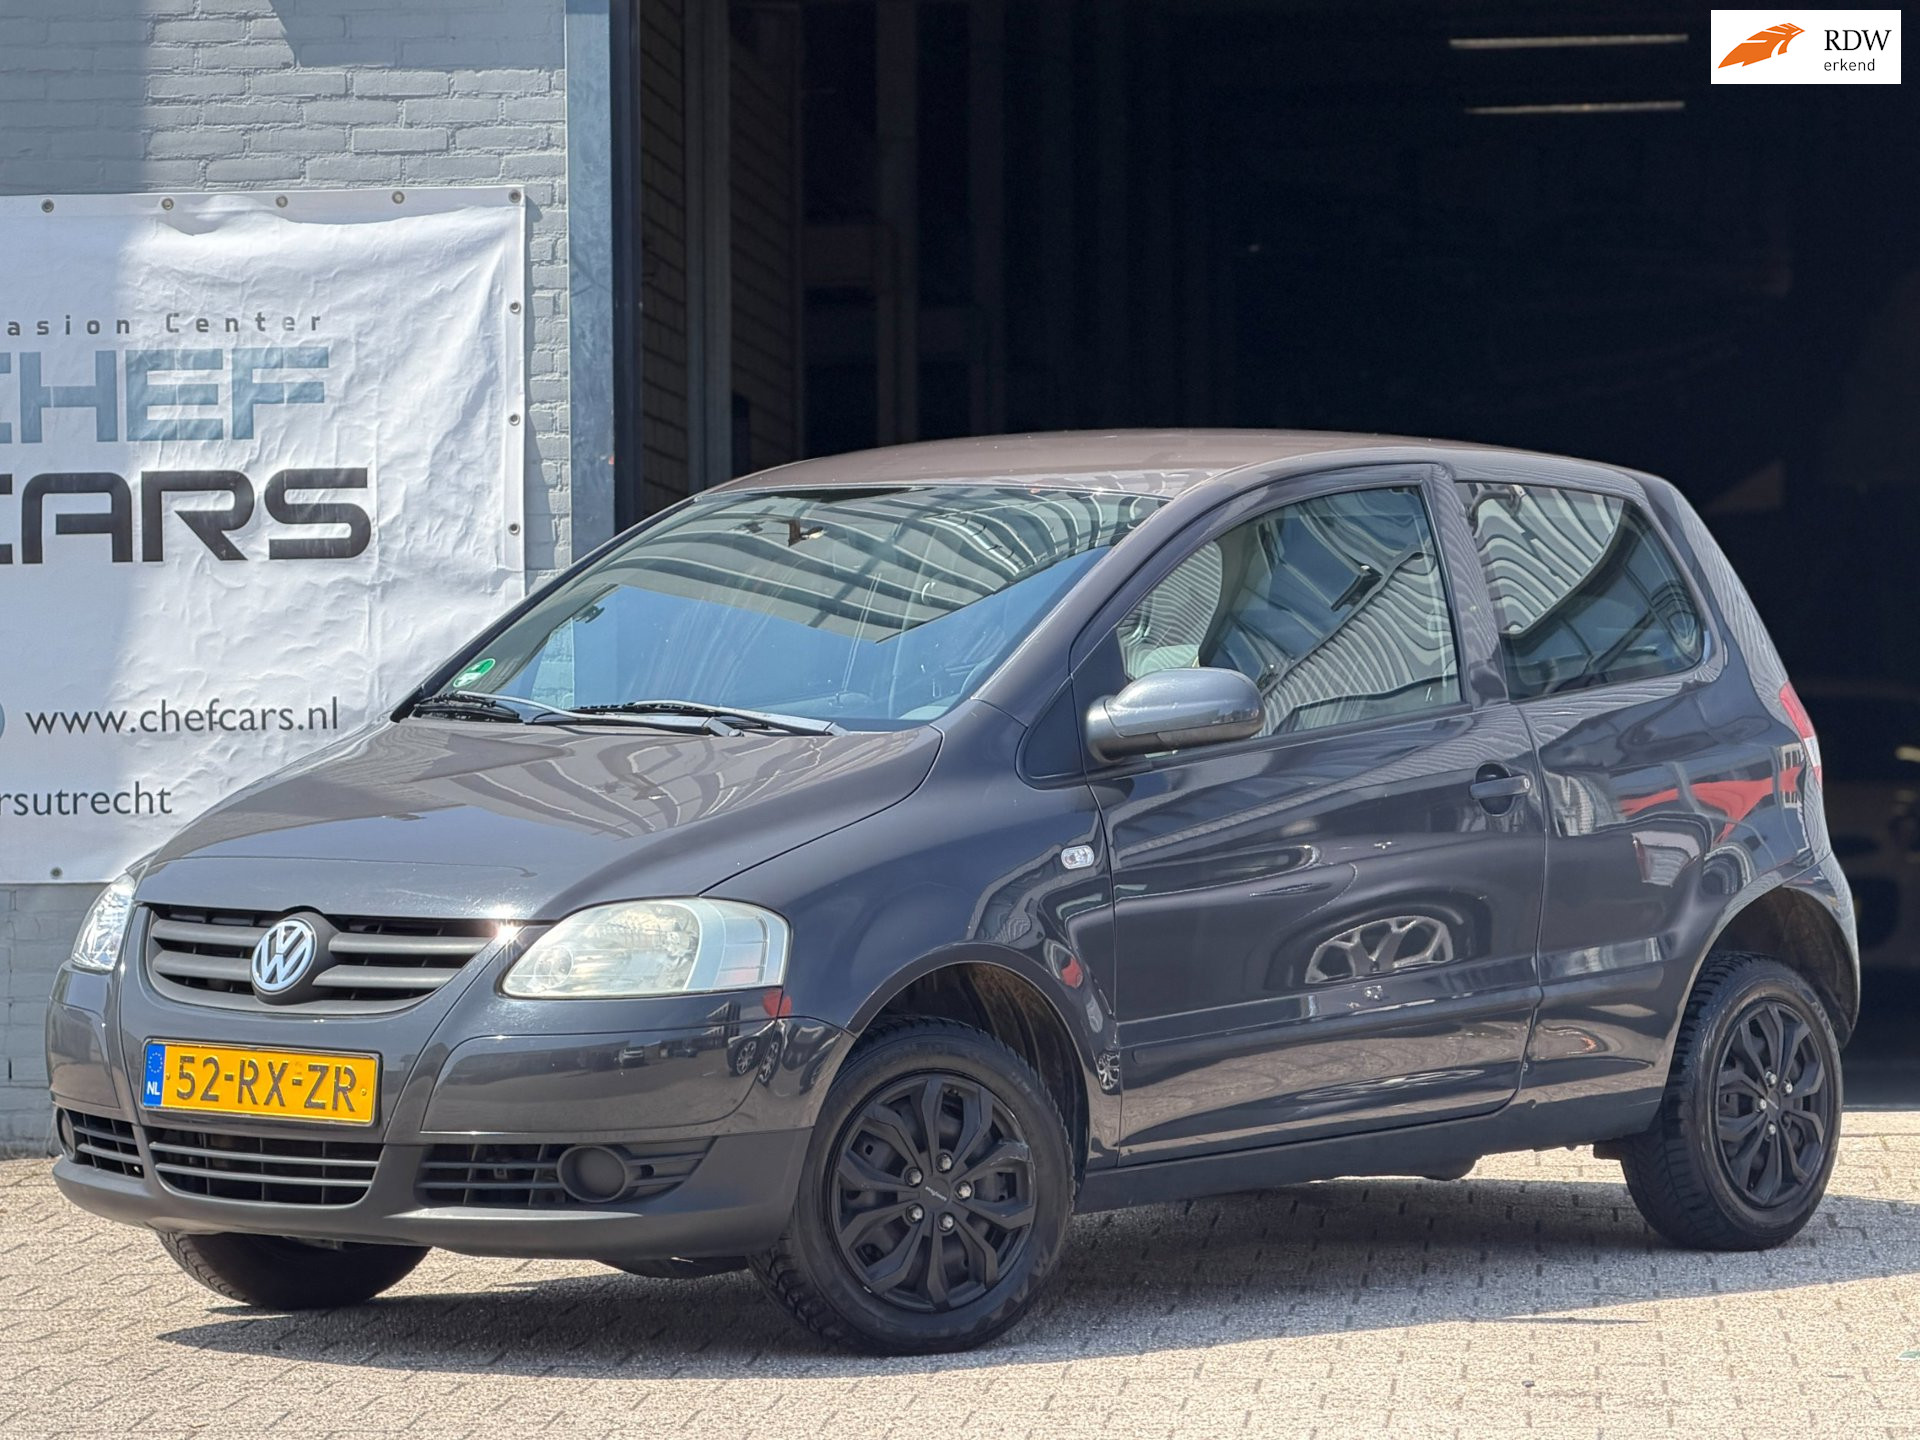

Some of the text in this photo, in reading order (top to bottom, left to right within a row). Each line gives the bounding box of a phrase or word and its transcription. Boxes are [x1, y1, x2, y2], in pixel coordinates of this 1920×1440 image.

[8, 312, 322, 336] asion Center
[0, 346, 329, 443] HEF
[0, 468, 371, 564] ARS
[25, 696, 339, 734] www.chefcars.nl
[253, 920, 315, 992] VW
[146, 1081, 161, 1096] NL
[176, 1054, 357, 1112] 52-RX-ZR
